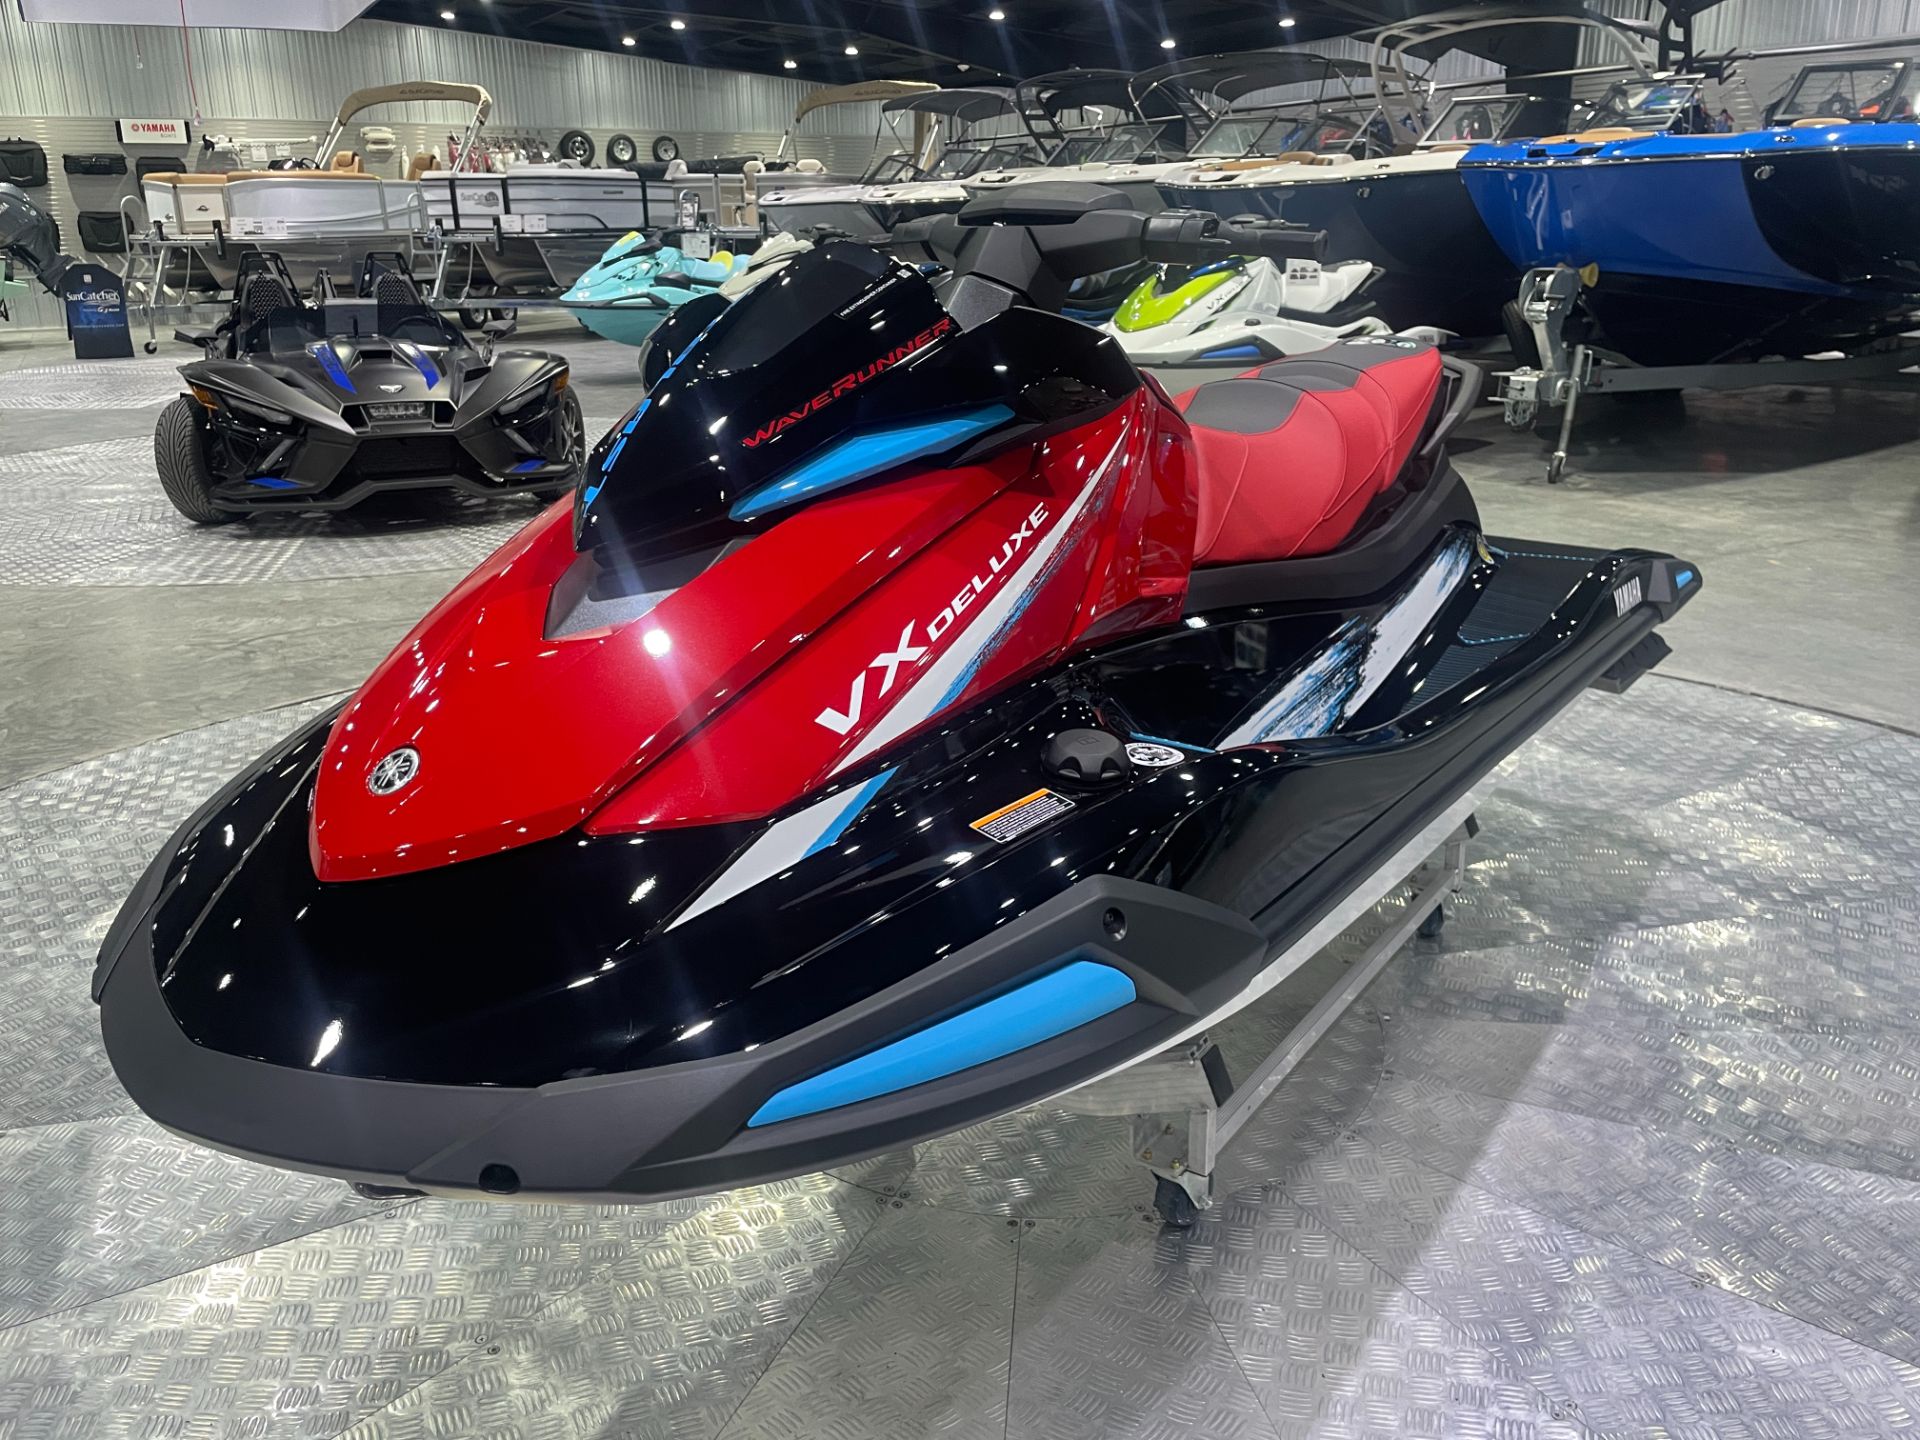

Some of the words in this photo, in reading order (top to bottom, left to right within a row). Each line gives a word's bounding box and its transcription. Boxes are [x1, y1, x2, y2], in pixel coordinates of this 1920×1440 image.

[140, 123, 176, 132] YAMAHA
[742, 317, 951, 447] WAVERUNNER
[814, 618, 928, 736] VX
[926, 502, 1049, 642] DELUXE
[1613, 576, 1642, 618] YAMAHA
